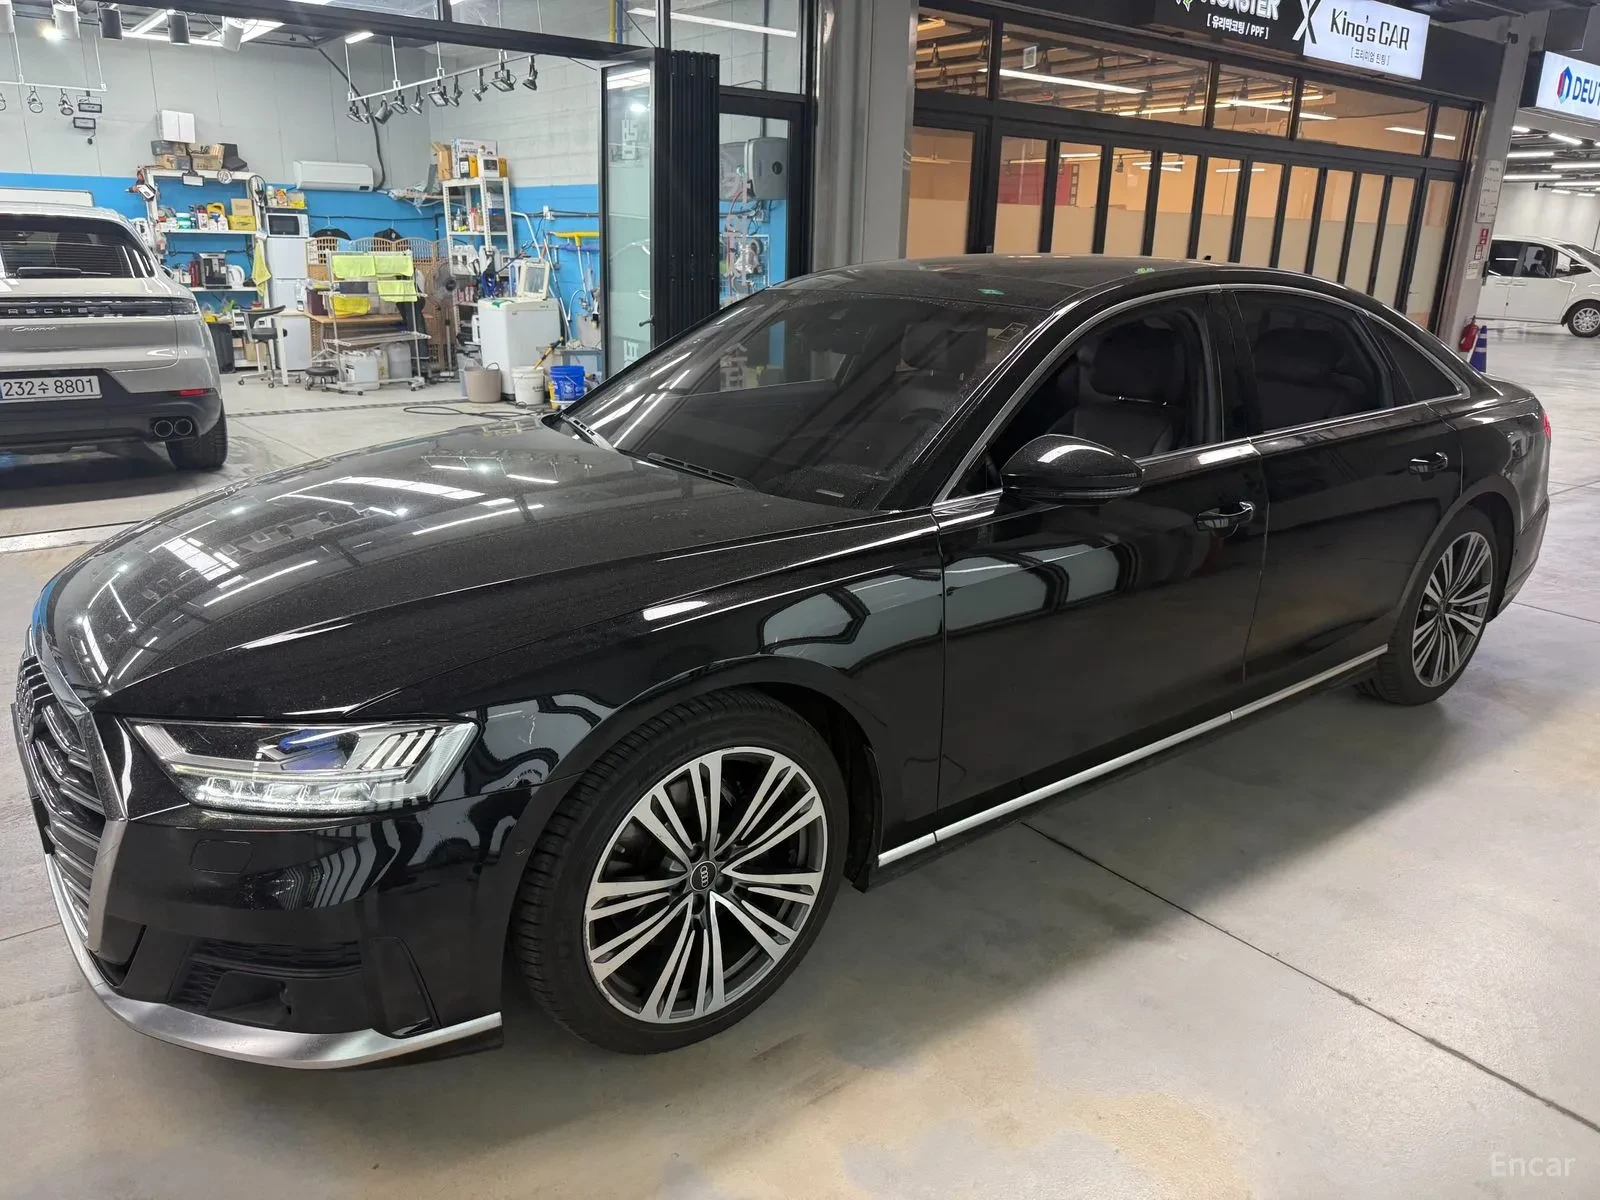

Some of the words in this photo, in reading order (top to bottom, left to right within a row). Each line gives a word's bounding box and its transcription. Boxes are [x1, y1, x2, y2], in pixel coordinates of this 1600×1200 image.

[1212, 15, 1245, 35] 유리막코팅
[1250, 24, 1265, 37] PPF
[1330, 8, 1376, 43] King's
[1378, 21, 1410, 50] CAR
[3, 380, 50, 397] 232수
[54, 378, 94, 395] 8801
